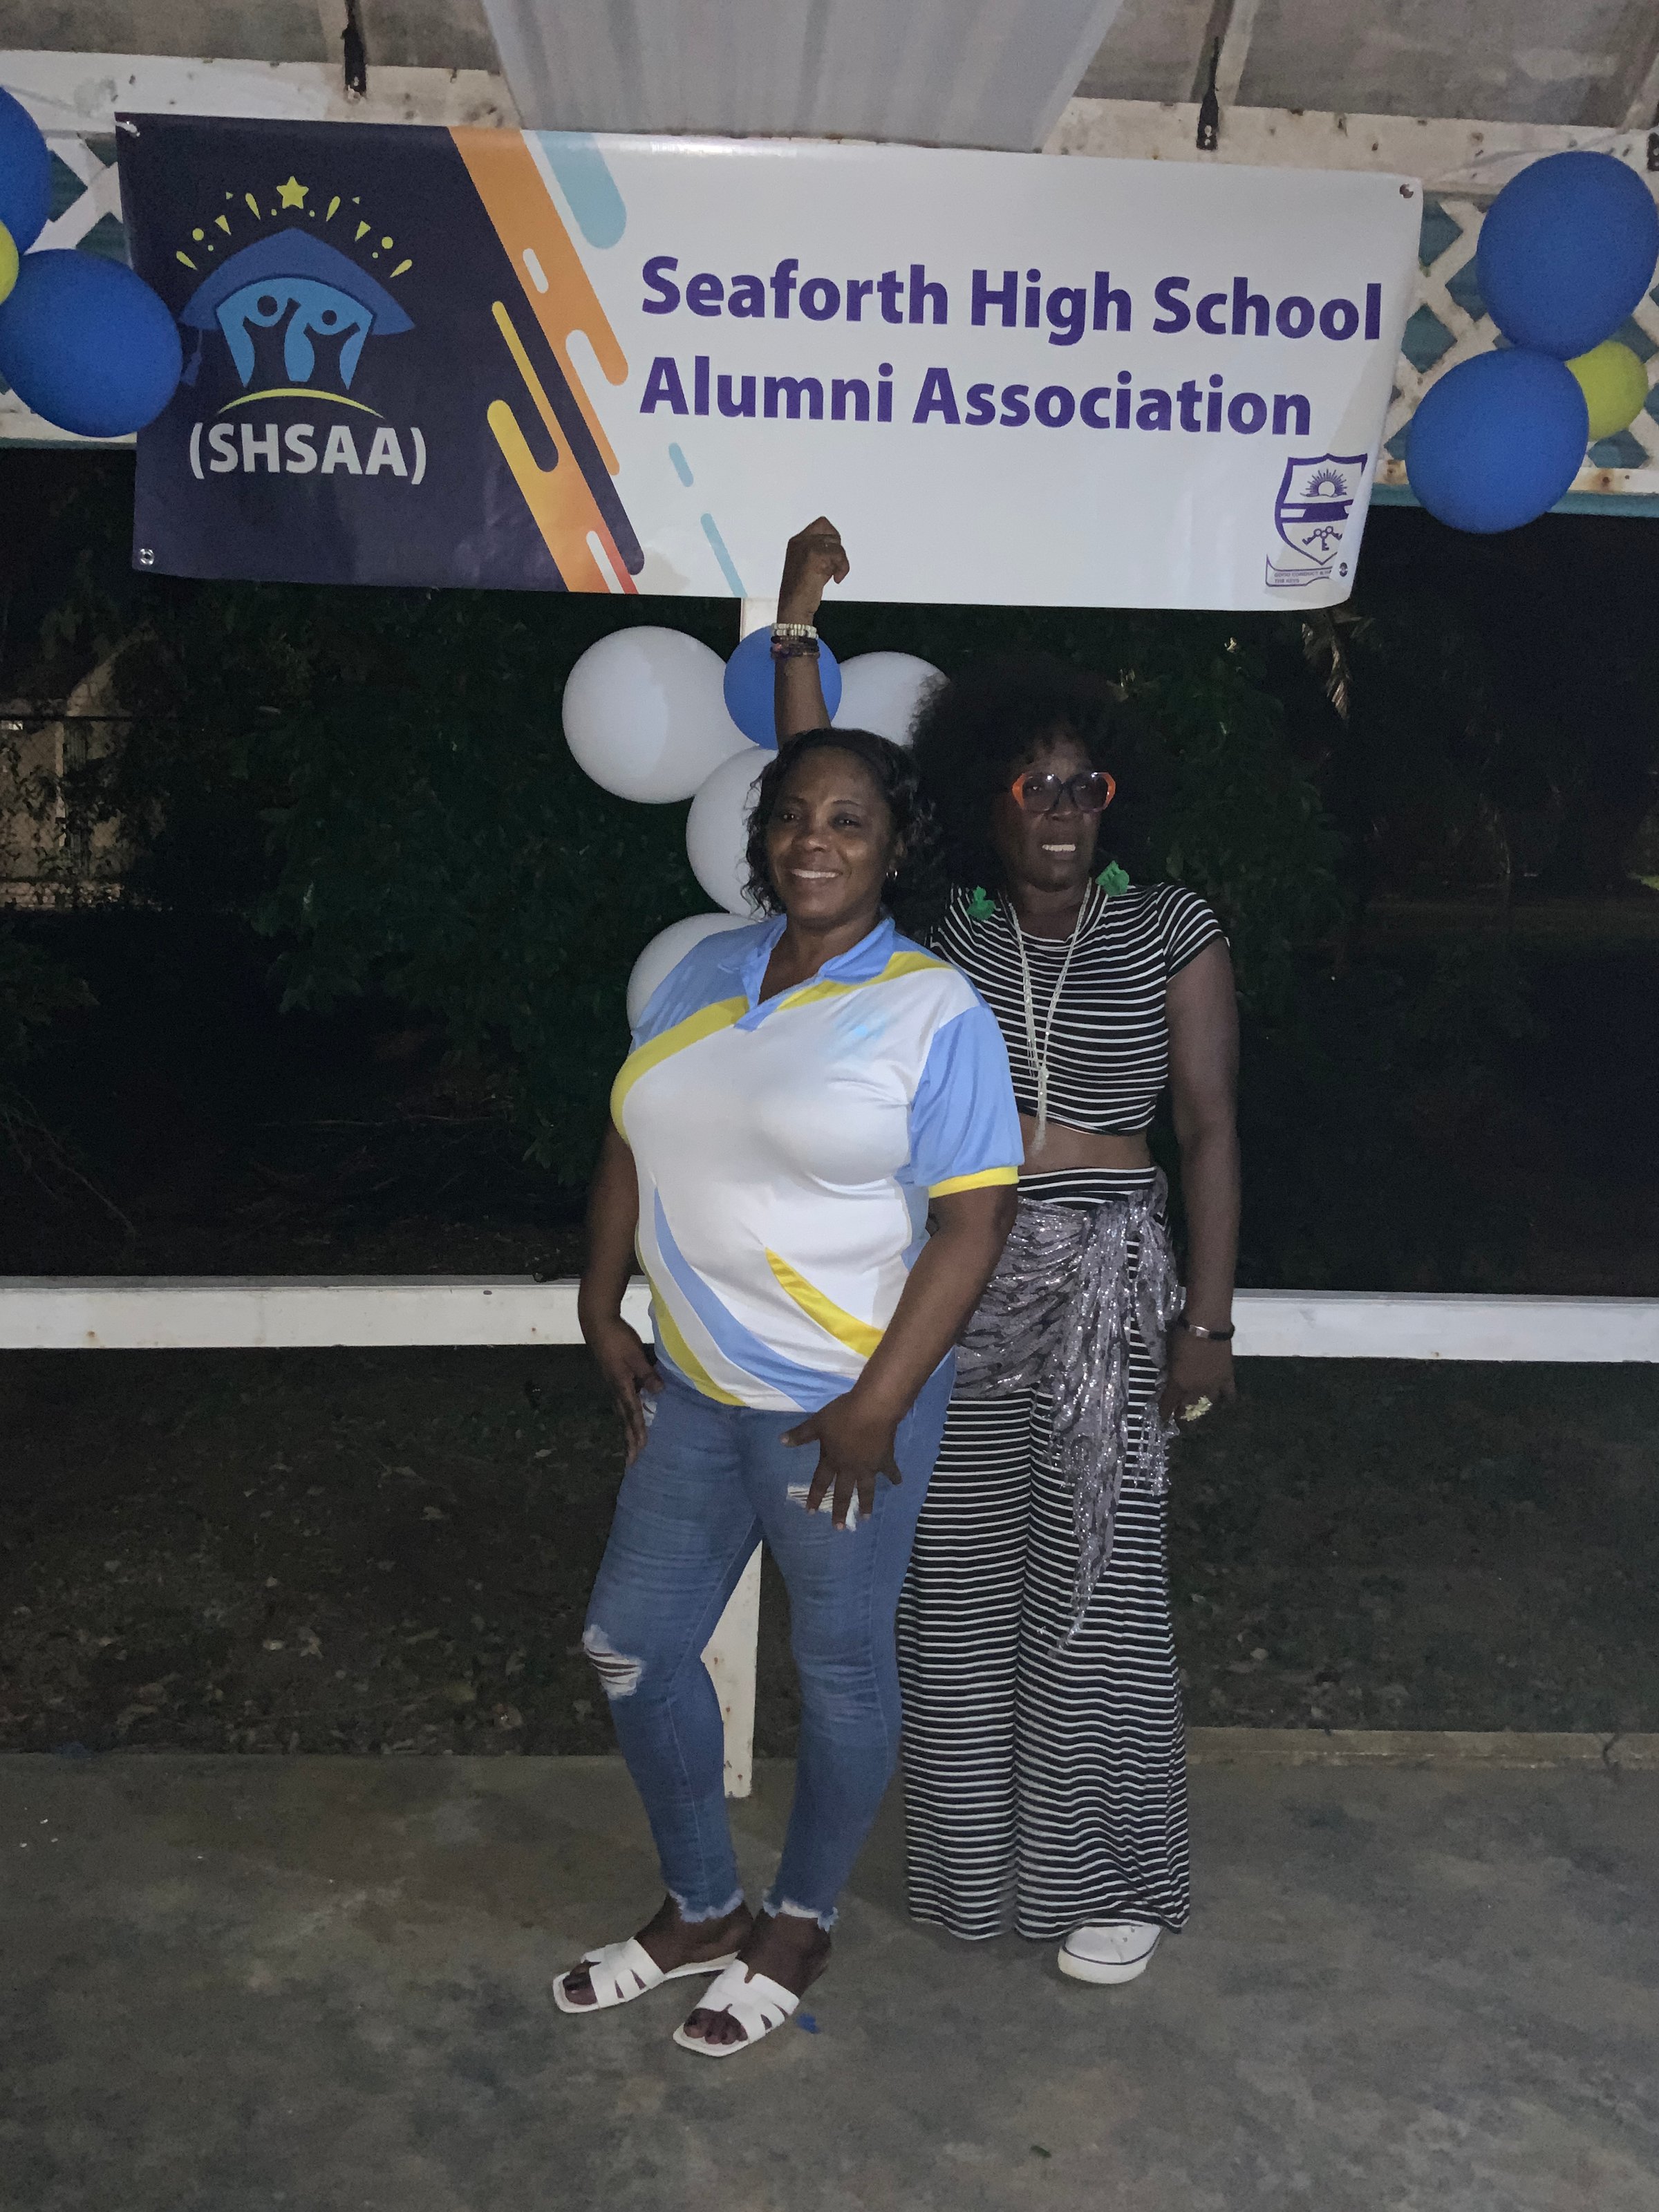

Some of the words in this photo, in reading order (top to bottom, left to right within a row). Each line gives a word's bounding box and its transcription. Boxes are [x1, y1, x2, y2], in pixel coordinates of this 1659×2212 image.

[641, 255, 948, 326] Seaforth
[971, 268, 1133, 347] High
[1152, 275, 1382, 341] School
[639, 355, 894, 423] Alumni
[912, 366, 1311, 436] Association
[189, 422, 427, 485] (SHSAA)
